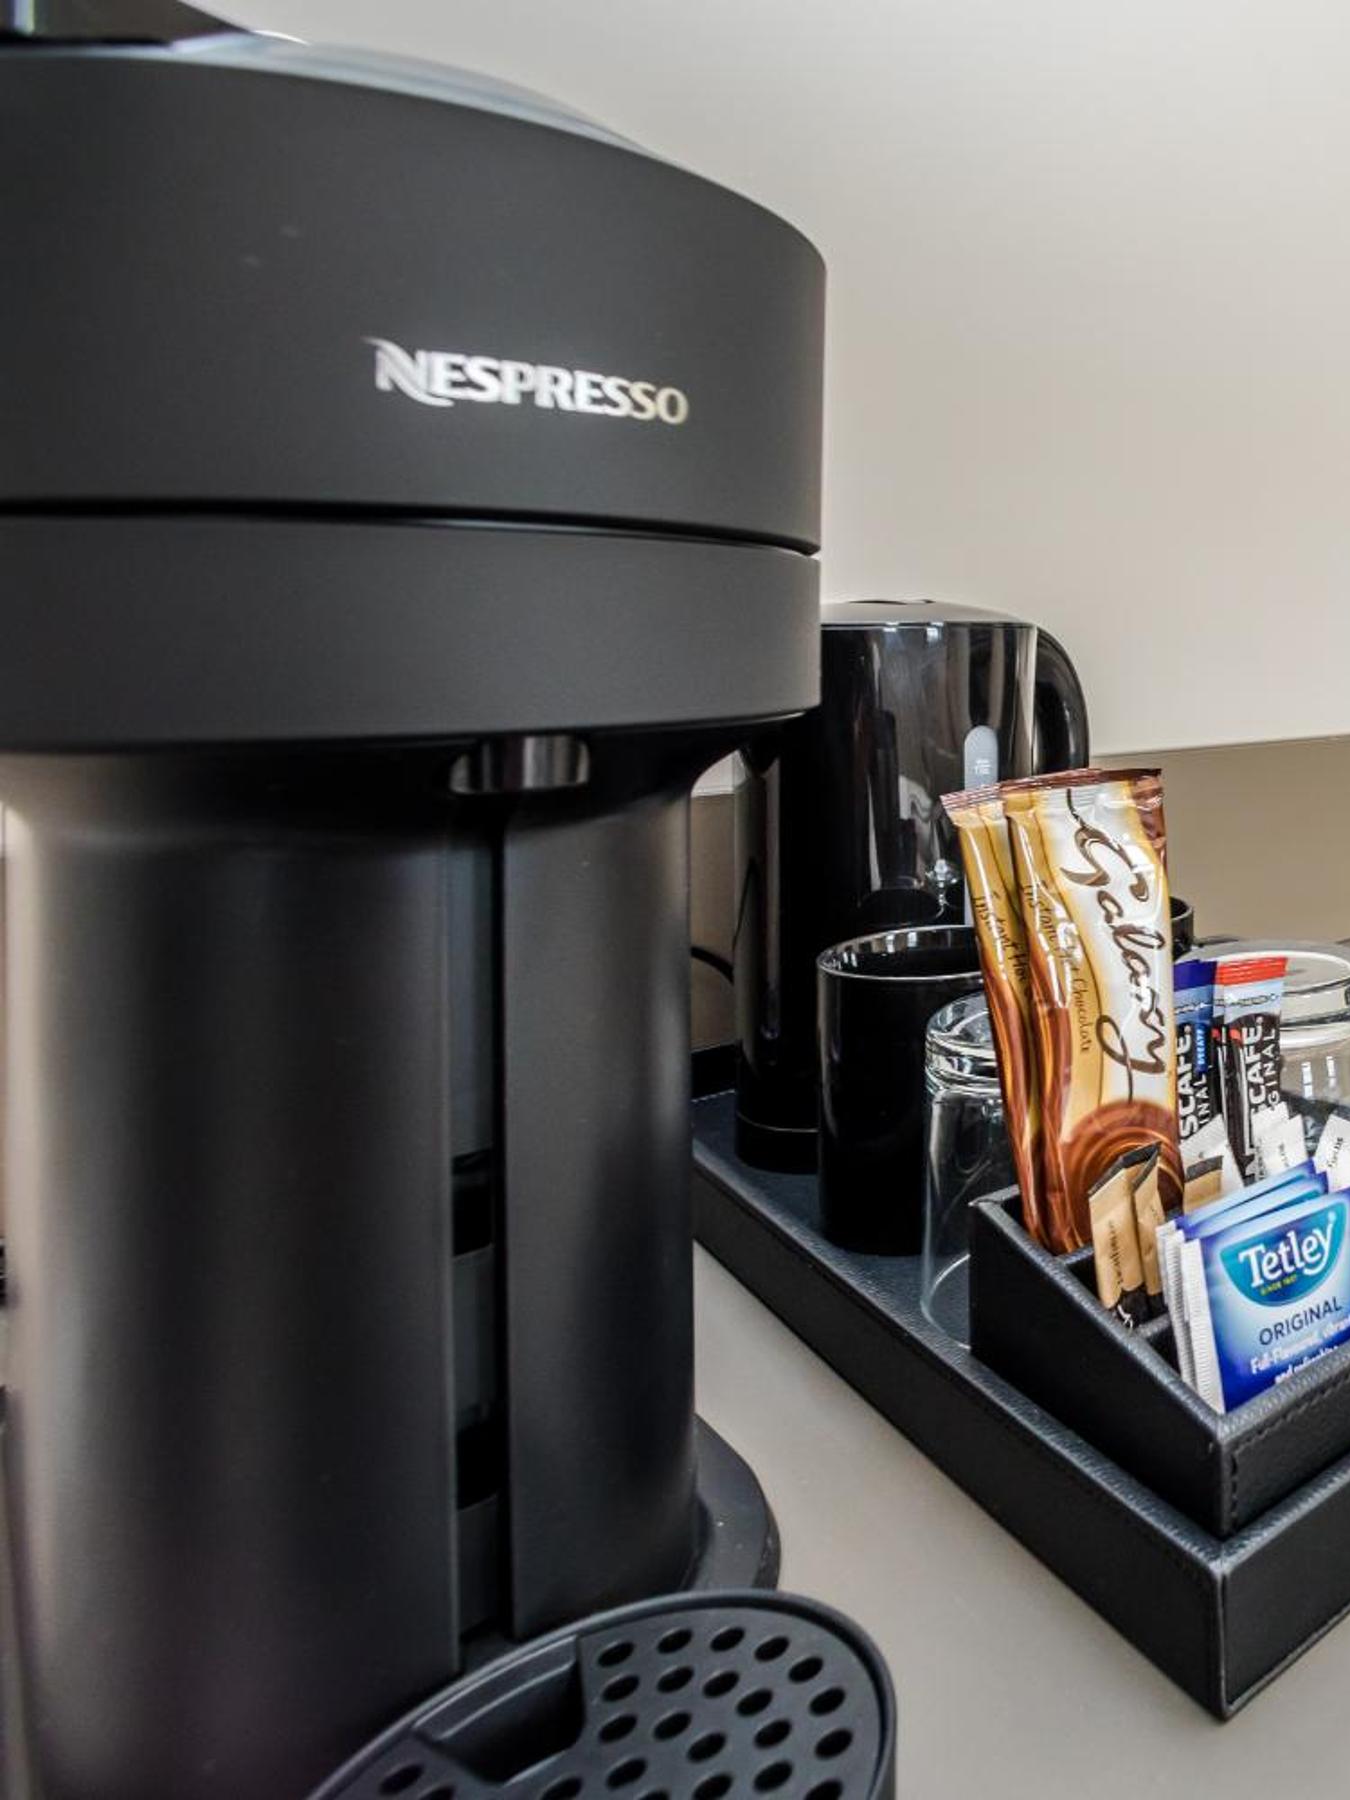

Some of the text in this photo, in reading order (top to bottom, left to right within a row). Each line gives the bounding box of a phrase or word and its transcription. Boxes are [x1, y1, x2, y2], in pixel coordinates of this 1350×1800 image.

[364, 337, 689, 425] NESPRESSO
[1238, 1211, 1338, 1289] Tetley
[1258, 1296, 1344, 1347] ORIGINAL
